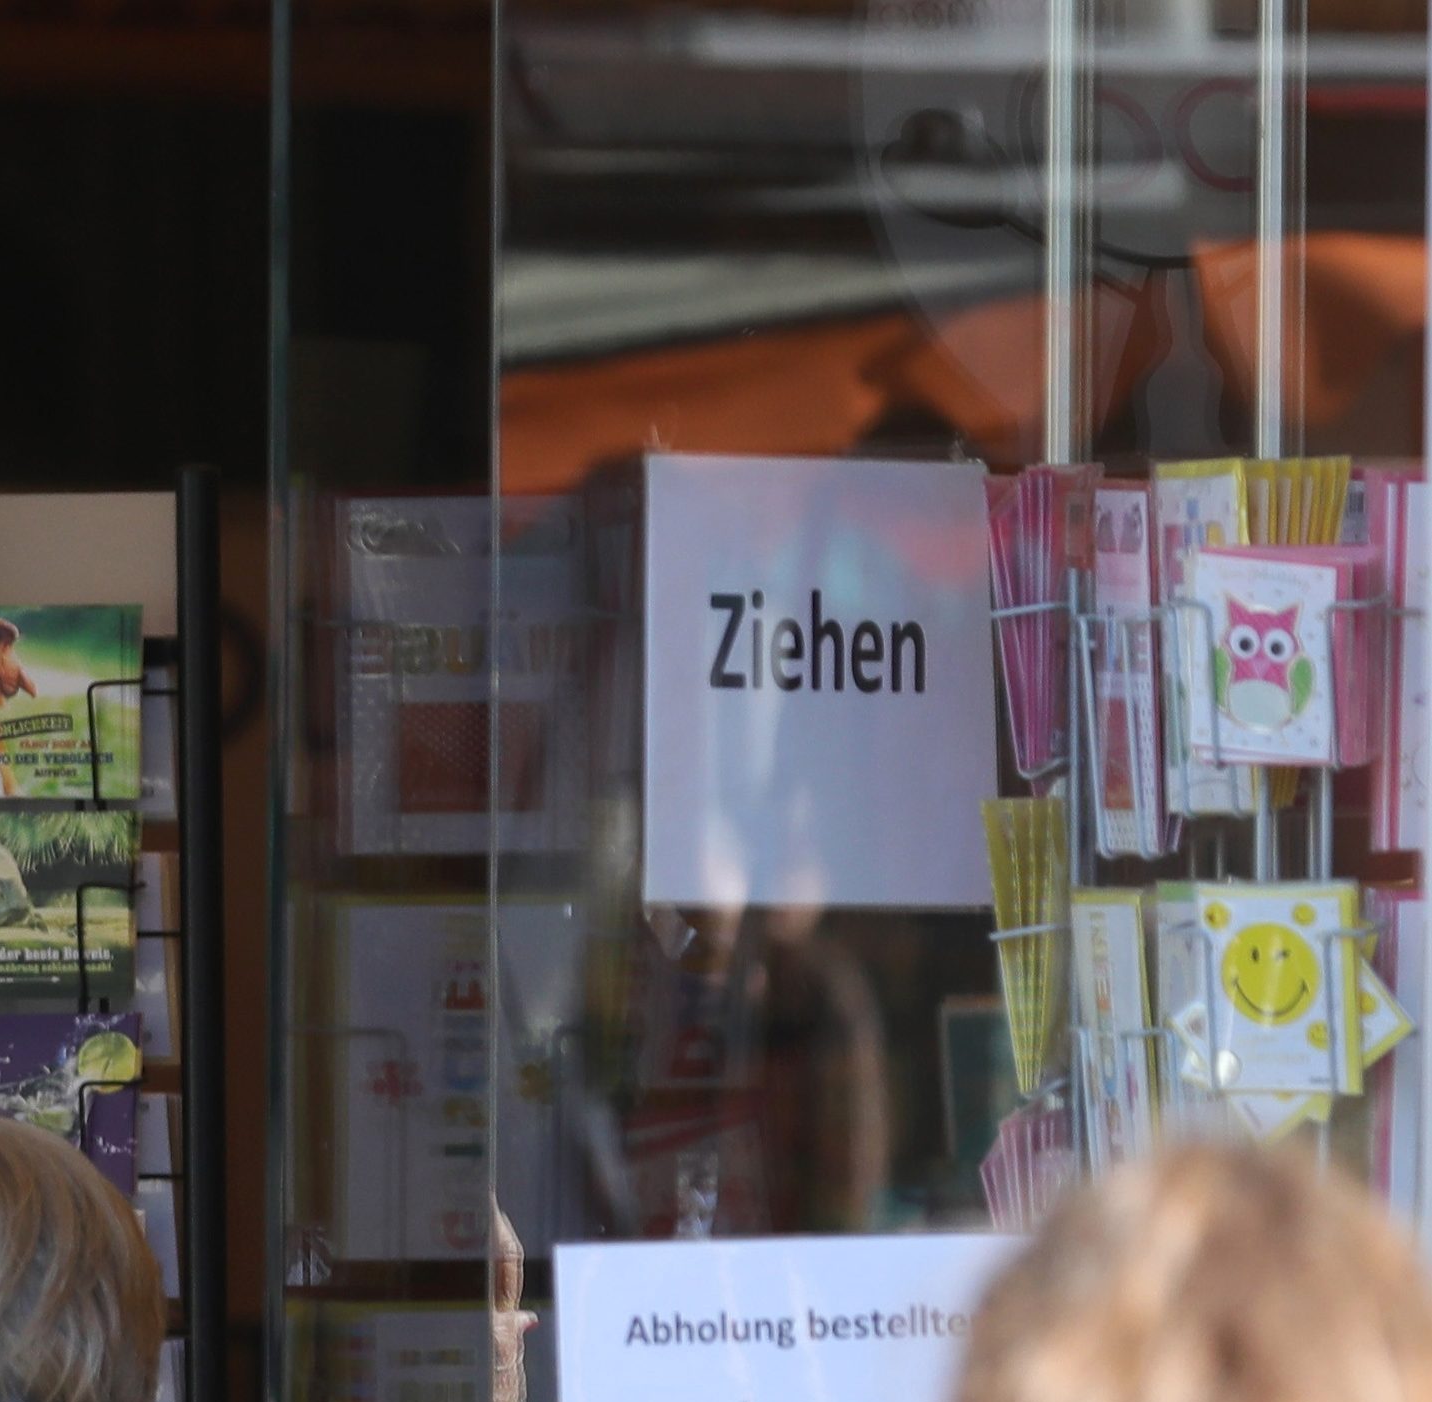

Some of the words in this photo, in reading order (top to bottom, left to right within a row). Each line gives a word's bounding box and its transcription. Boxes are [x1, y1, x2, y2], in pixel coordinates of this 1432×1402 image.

[709, 588, 927, 693] Ziehen
[15, 752, 39, 765] DER
[44, 752, 114, 765] VERGLECH
[24, 947, 60, 962] beste
[624, 1310, 796, 1349] Abholung
[807, 1303, 971, 1340] bestellte
